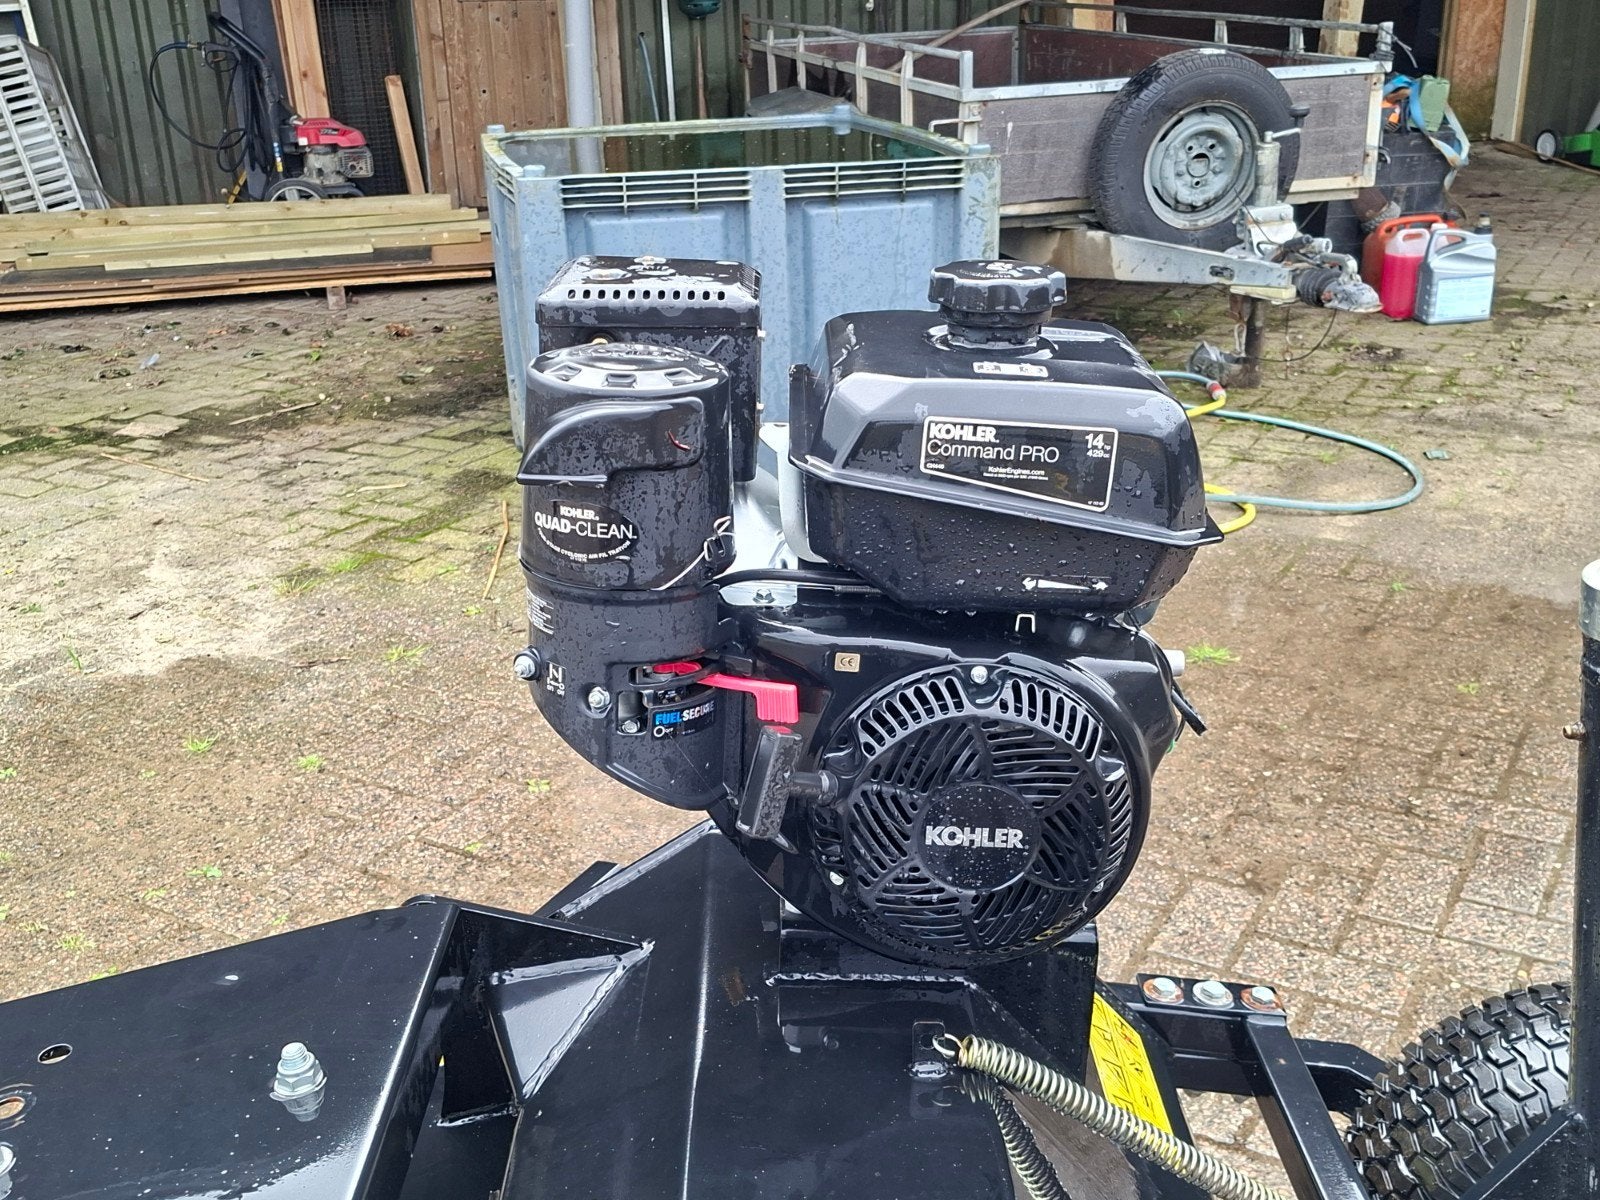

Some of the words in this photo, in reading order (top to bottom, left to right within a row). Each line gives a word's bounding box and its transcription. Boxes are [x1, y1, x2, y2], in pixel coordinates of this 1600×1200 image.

[929, 422, 998, 443] KOHLER
[927, 439, 1015, 460] Command
[1020, 445, 1060, 463] PRO
[988, 466, 1045, 477] KohlerEngines.com
[560, 505, 598, 521] KOHLER
[534, 511, 636, 539] QUAD-CLEAN
[925, 825, 1024, 849] KOHLER
